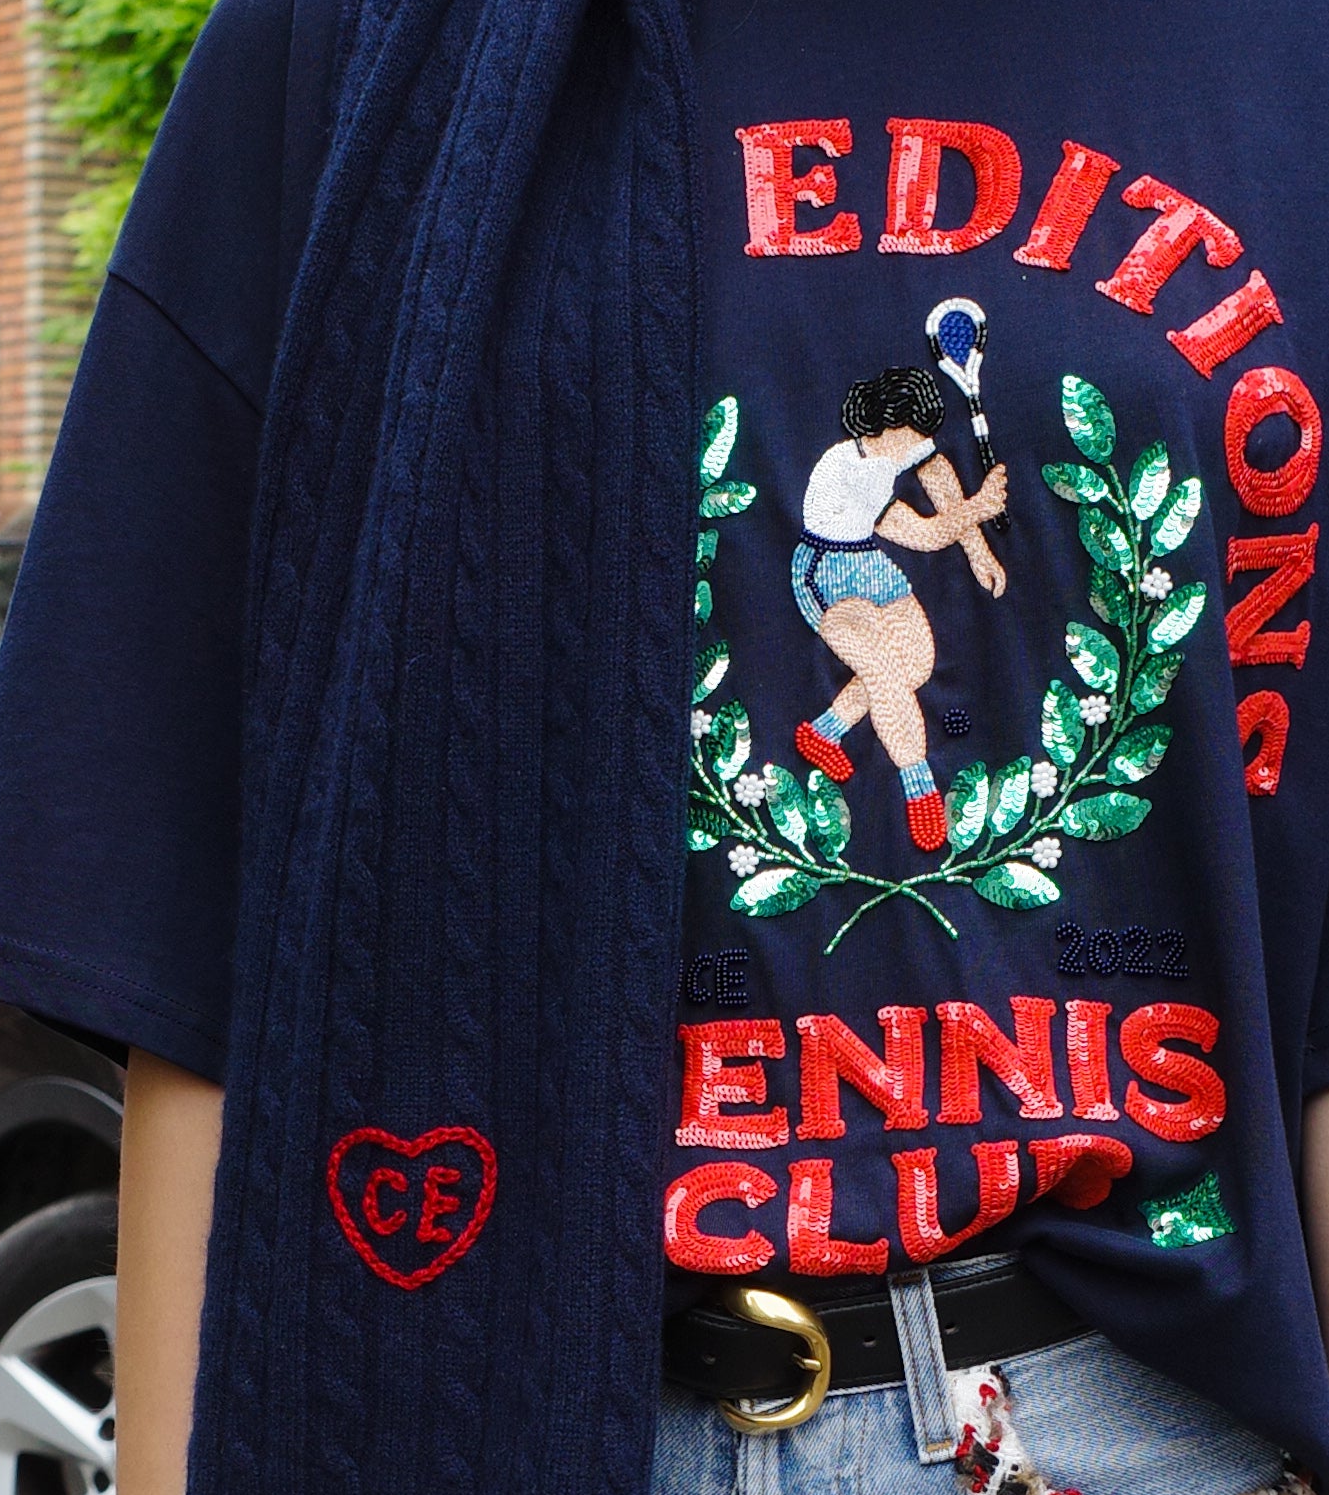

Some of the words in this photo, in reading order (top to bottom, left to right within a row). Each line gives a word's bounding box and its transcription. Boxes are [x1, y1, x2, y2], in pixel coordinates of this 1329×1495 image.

[735, 117, 1323, 796] EDITIONS
[676, 948, 750, 1005] CE
[1055, 921, 1190, 978] 2022
[675, 996, 1226, 1149] ENNIS
[362, 1167, 462, 1243] CE
